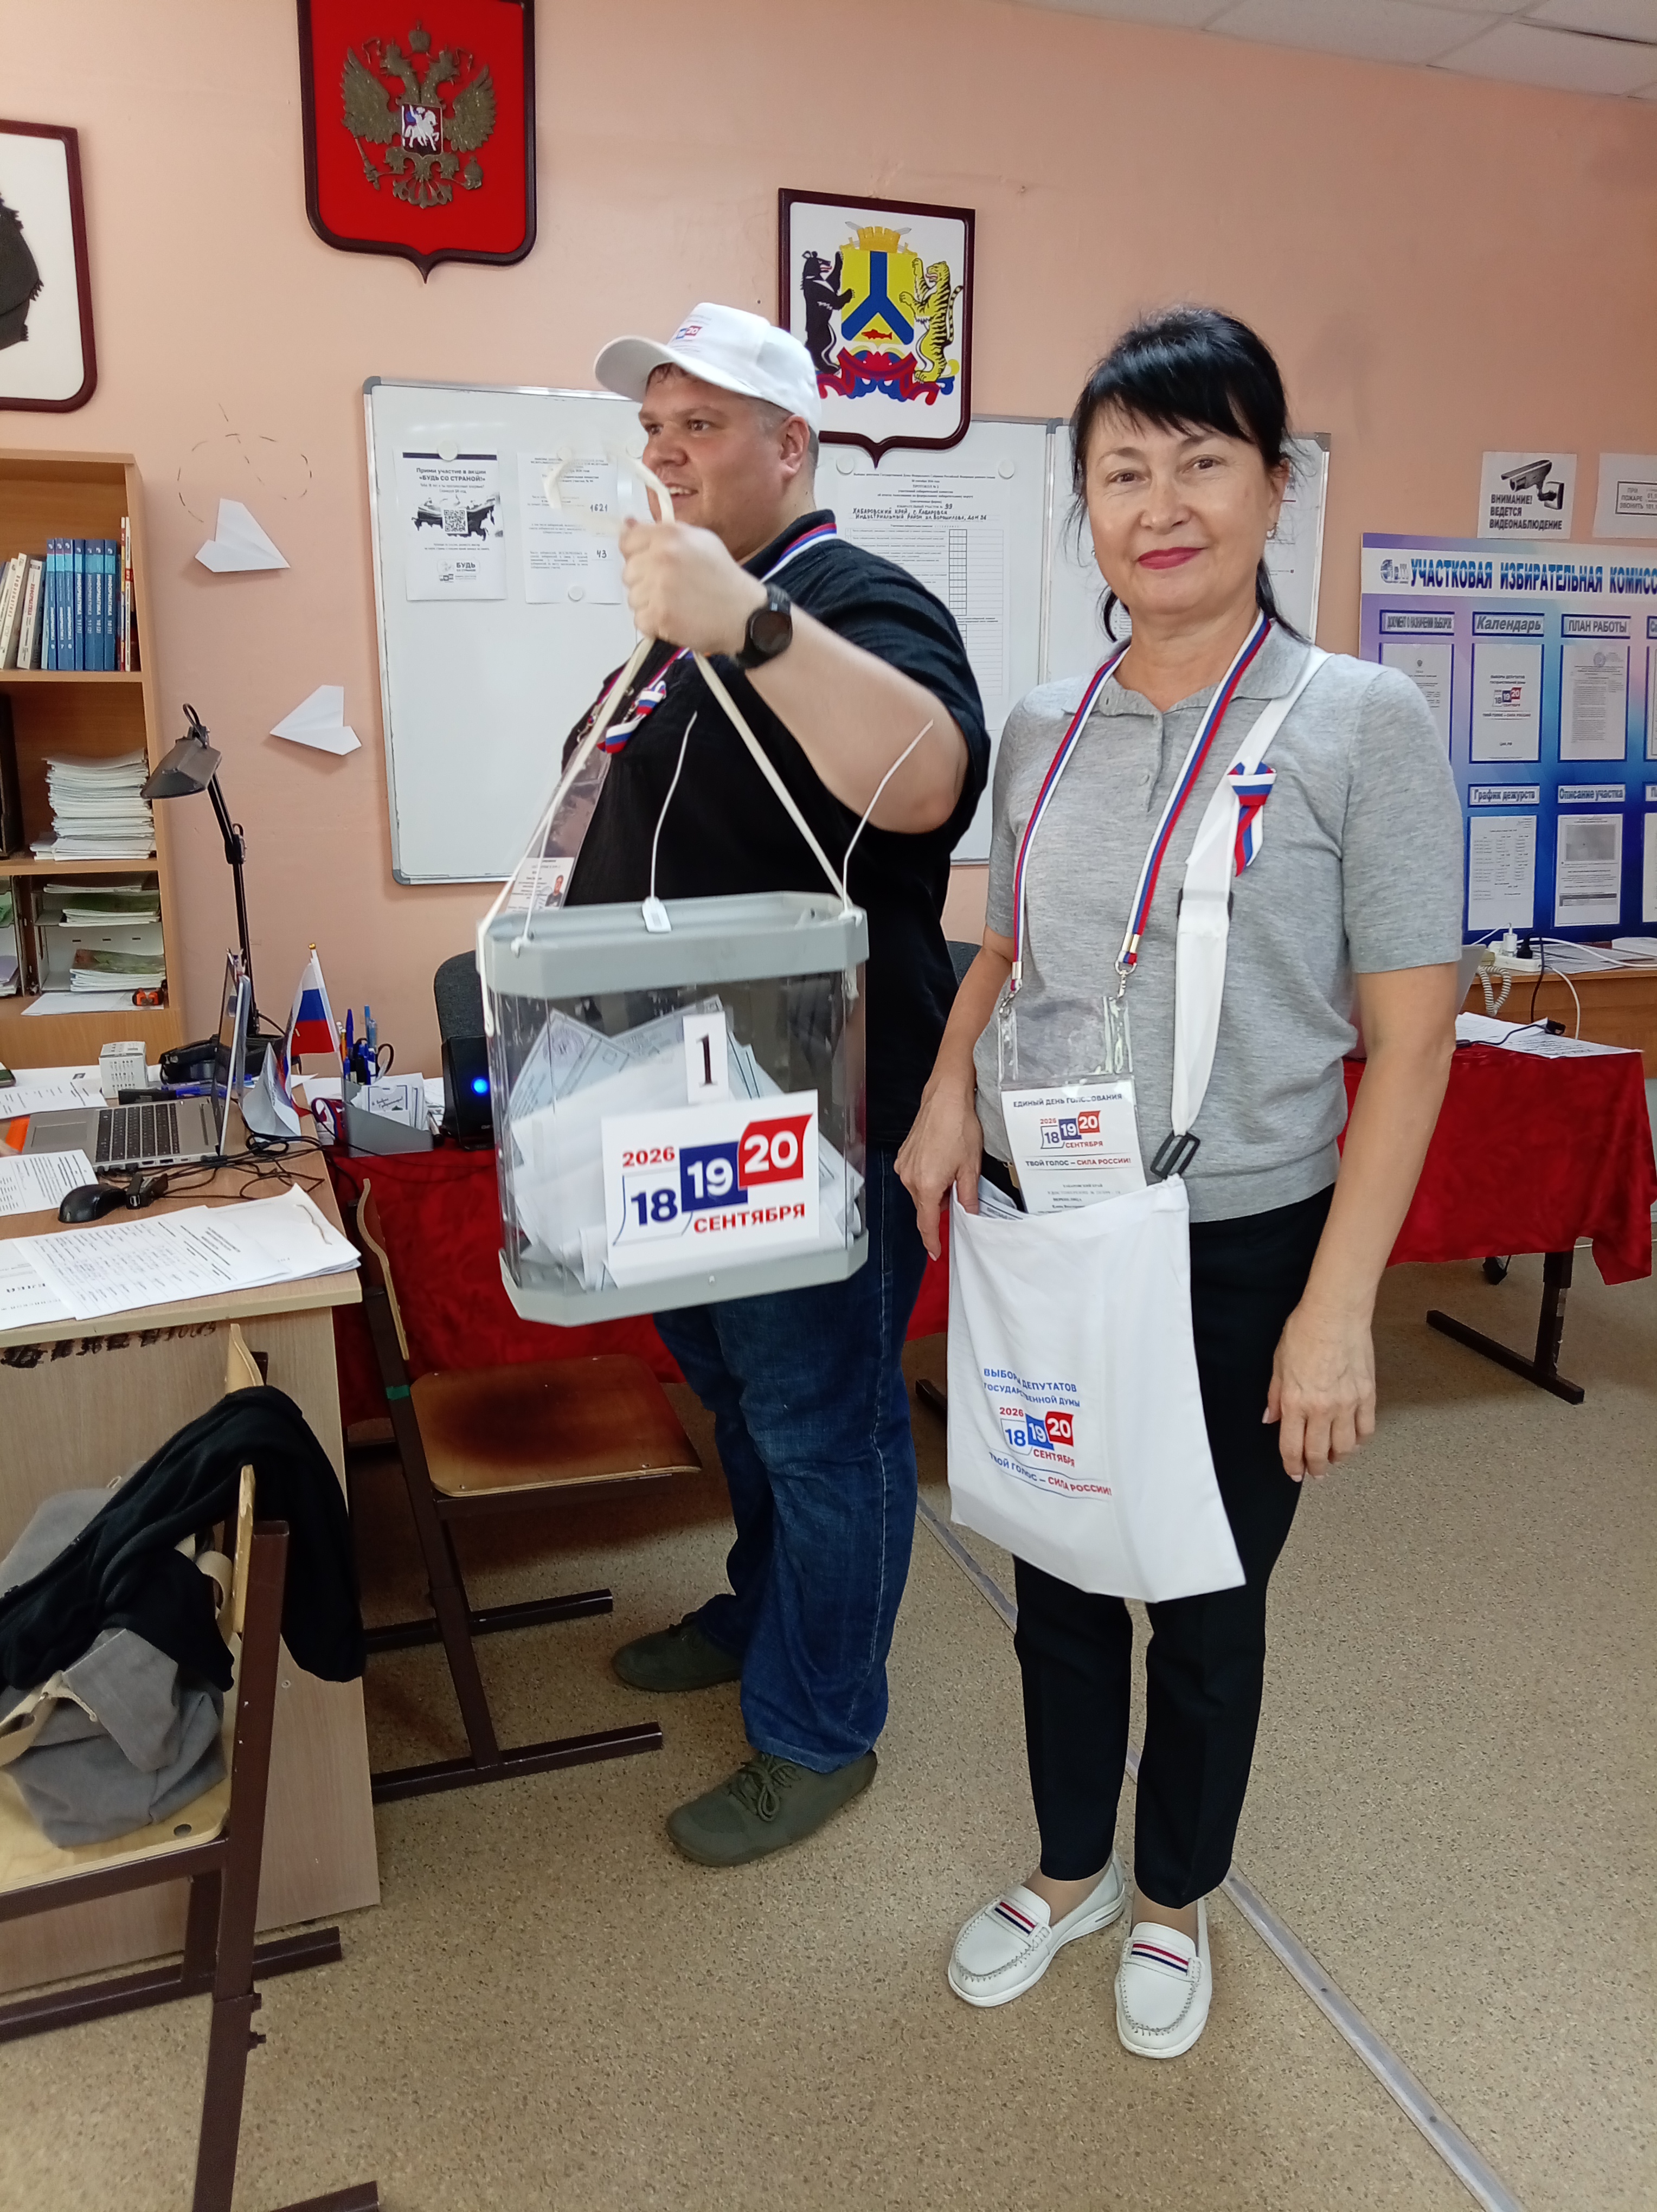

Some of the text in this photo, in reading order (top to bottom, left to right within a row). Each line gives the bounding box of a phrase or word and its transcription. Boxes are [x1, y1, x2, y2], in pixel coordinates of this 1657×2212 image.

[1491, 493, 1532, 504] ВНИМАНИЕ!
[590, 503, 608, 512] 1621
[1490, 506, 1522, 518] ВЕДЕТСЯ
[1489, 518, 1563, 531] ВИДЕОНАБЛЮДЕНИЕ
[596, 549, 607, 558] 43
[1411, 558, 1493, 589] УЧАСТКОВАЯ
[1500, 562, 1603, 593] ИЗБИРАТЕЛЬНАЯ
[1476, 615, 1542, 633] Календарь
[1568, 619, 1627, 633] ПЛАН РАБОТЫ
[1474, 789, 1535, 802] График дежурств
[1559, 788, 1623, 801] Описание участка
[695, 1032, 718, 1088] 1
[1013, 1098, 1044, 1108] ЕДИНЫЙ
[1044, 1115, 1098, 1144] 18 19 20
[1065, 1140, 1103, 1149] СЕНТЯБРЯ
[622, 1146, 676, 1168] 2026
[630, 1130, 799, 1227] 18 19 20
[693, 1202, 806, 1234] СЕНТЯБРЯ
[1022, 1379, 1077, 1392] ДЕПУТАТОВ
[1059, 1397, 1081, 1407] ДУМЫ
[999, 1407, 1024, 1417] 2026
[1005, 1417, 1071, 1447] 18 19 20
[1033, 1449, 1075, 1468] СЕНТЯБРЯ
[1011, 1462, 1038, 1481] ГОЛОС
[1048, 1476, 1070, 1491] СИЛА
[1070, 1483, 1113, 1496] РОССИИ!
